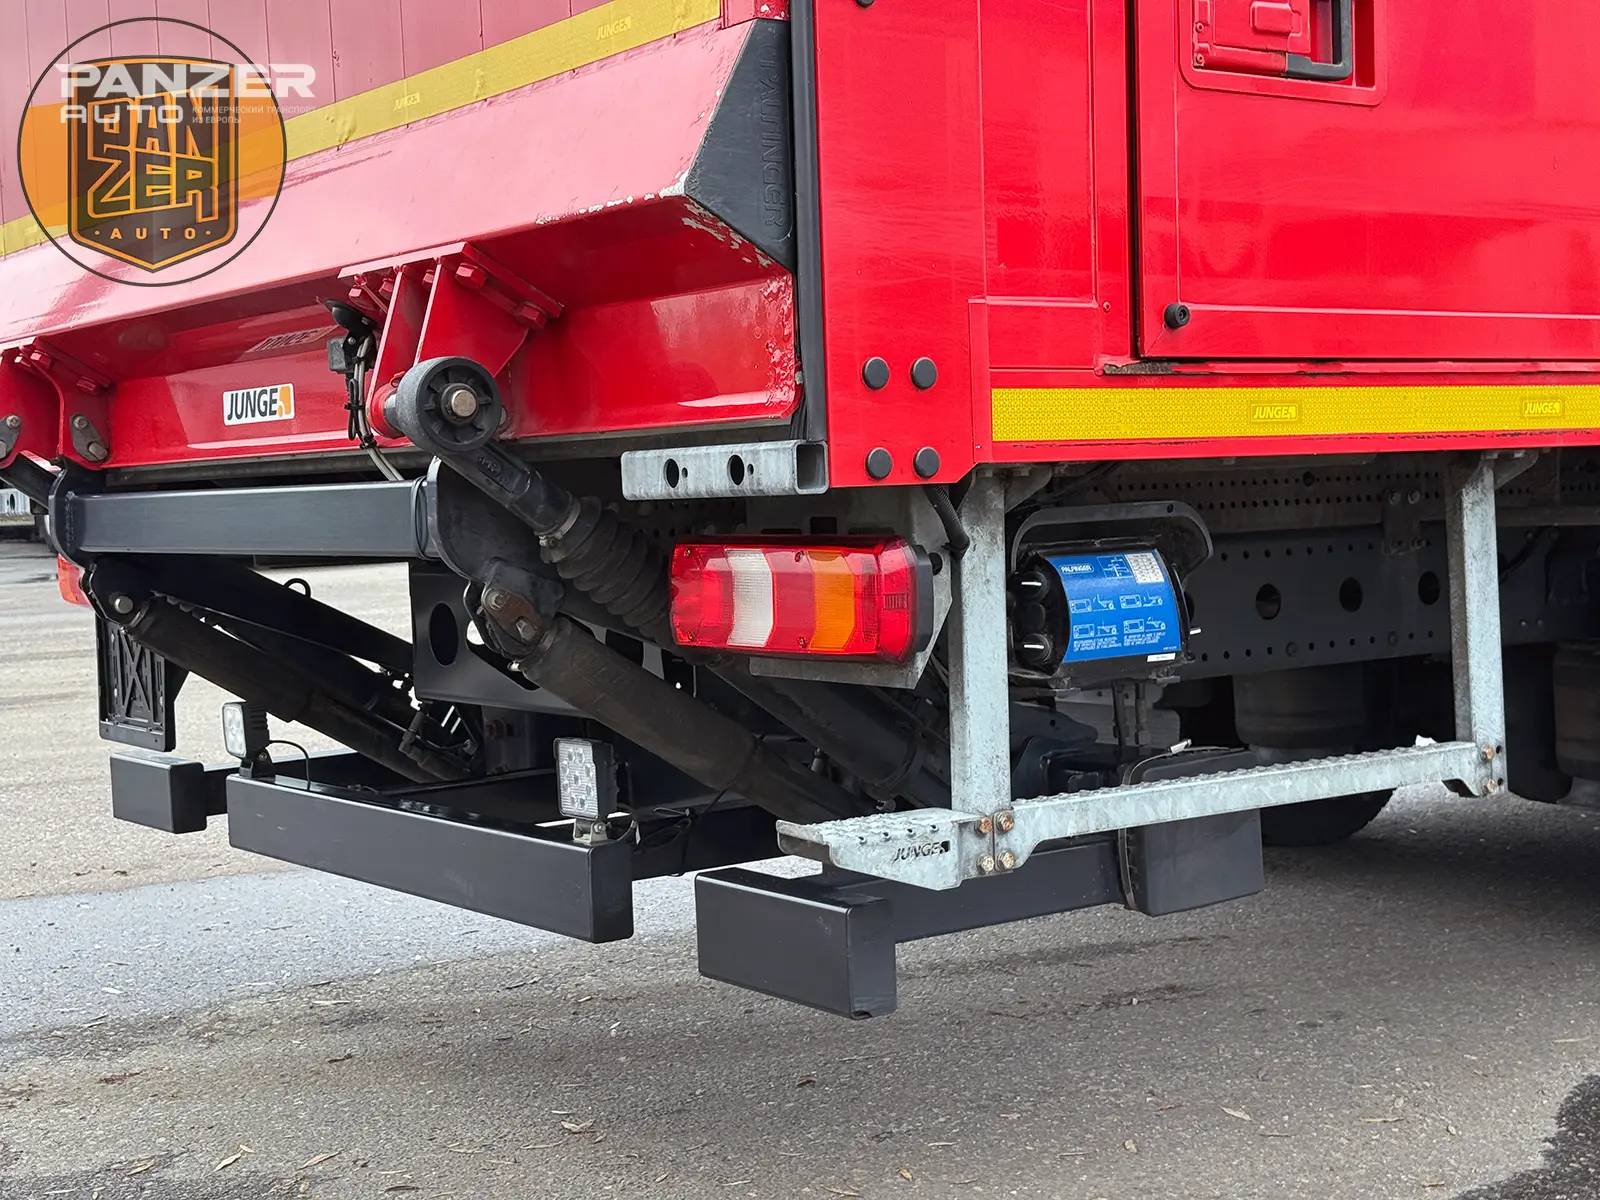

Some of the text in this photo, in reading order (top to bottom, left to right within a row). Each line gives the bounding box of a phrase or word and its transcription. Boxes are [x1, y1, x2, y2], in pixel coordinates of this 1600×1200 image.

[597, 19, 624, 40] JUNGE
[227, 387, 279, 421] JUNGE
[1252, 405, 1289, 420] JUNGE
[1524, 401, 1553, 415] JUNGE
[893, 841, 941, 861] JUNGE
